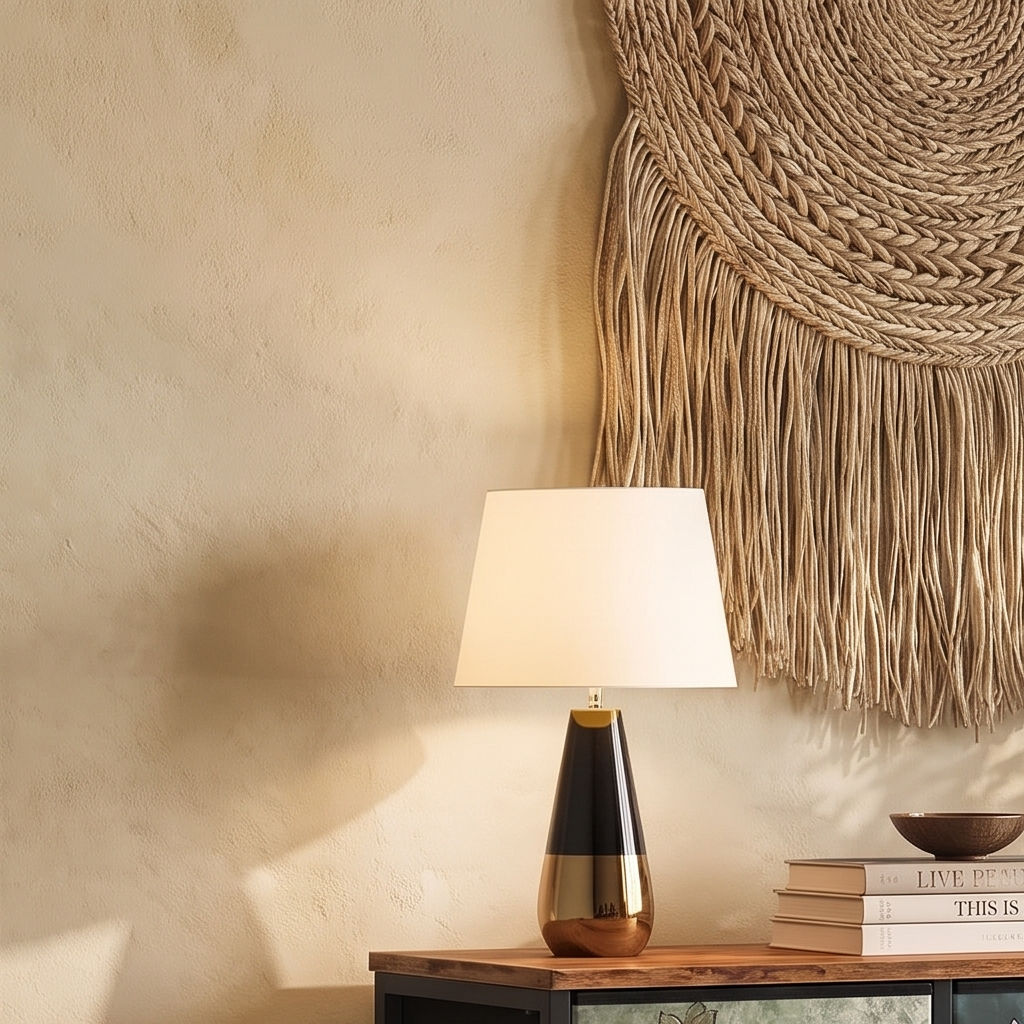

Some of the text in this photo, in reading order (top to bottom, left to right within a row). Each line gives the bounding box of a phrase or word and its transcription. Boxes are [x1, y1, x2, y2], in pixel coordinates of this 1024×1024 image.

[917, 870, 964, 889] LIVE
[954, 900, 998, 917] THIS
[1003, 899, 1019, 916] IS
